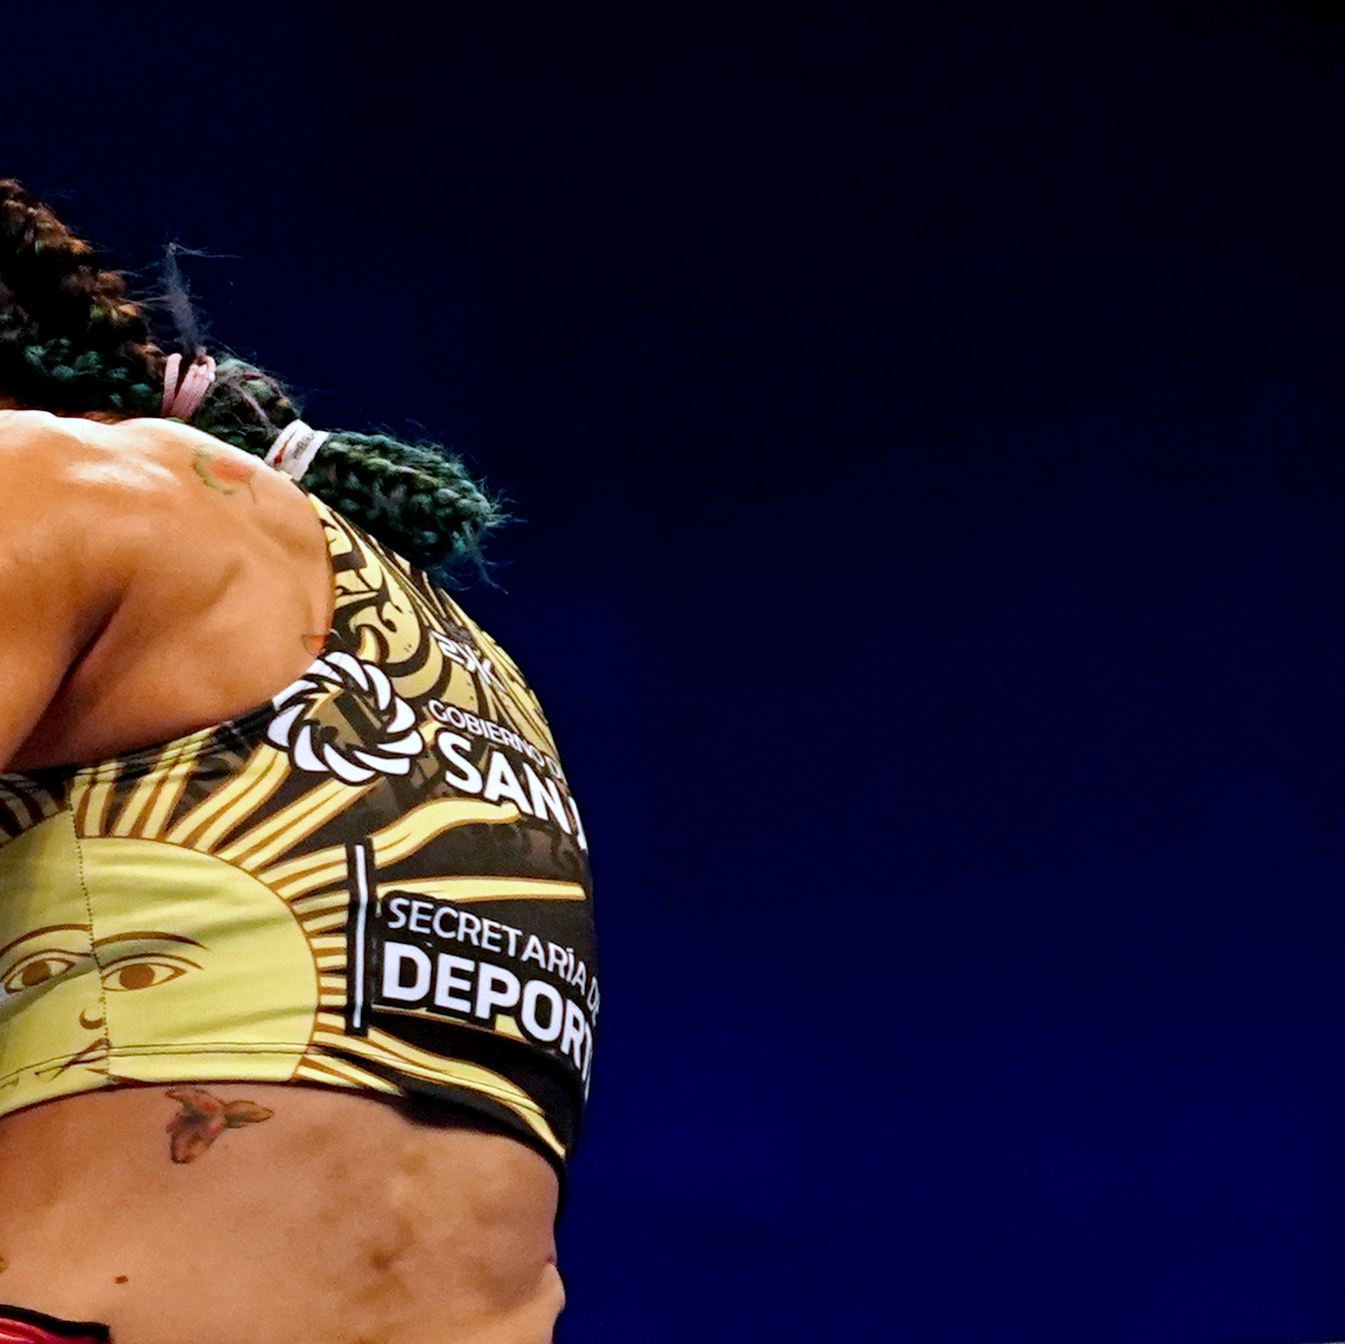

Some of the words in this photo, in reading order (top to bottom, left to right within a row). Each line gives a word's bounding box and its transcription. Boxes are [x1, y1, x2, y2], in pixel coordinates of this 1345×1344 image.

[428, 699, 546, 768] GOBIERNO
[437, 730, 573, 836] SAN
[382, 940, 593, 1085] DEPORT
